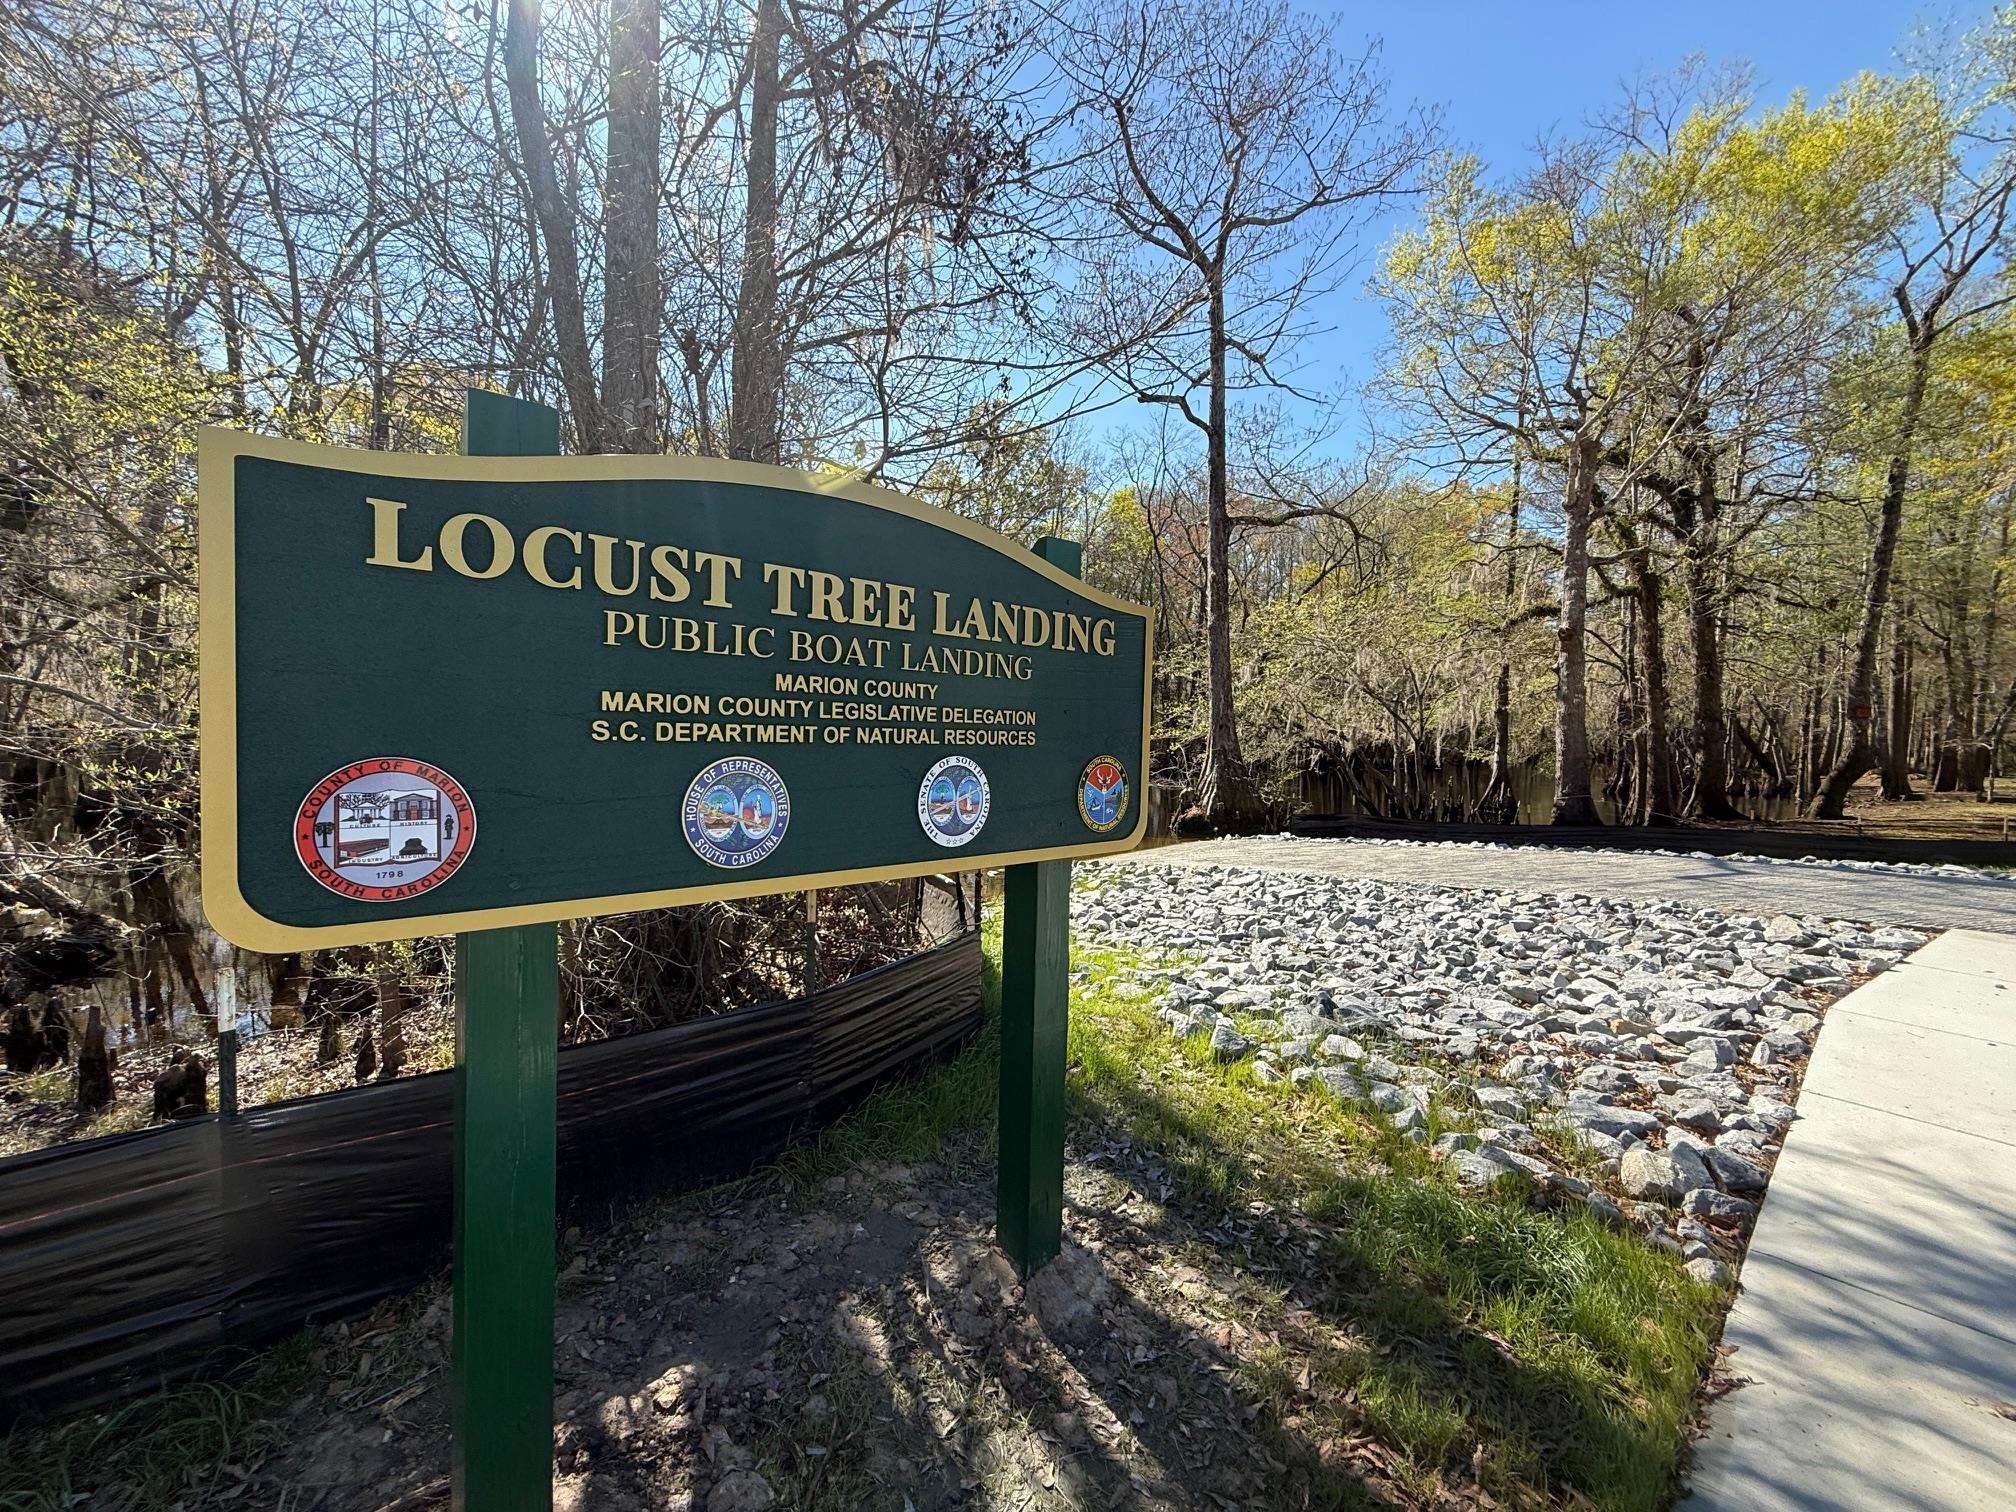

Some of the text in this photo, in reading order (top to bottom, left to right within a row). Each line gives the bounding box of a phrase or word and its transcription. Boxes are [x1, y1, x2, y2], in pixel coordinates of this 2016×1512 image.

[365, 496, 1116, 656] LOCUST TREE LANDING
[602, 609, 1033, 681] PUBLIC BOAT LANDING
[775, 673, 939, 700] MARION COUNTY
[601, 690, 1036, 726] MARION COUNTY LEGISLATIVE DELEGATION
[591, 720, 1036, 746] S.C. DEPARTMENT OF NATURAL RESOURCES
[938, 757, 952, 769] OF
[955, 756, 985, 778] SOUTH
[303, 761, 470, 819] COUNTY OF MARION
[686, 784, 705, 822] HOUSE
[703, 768, 717, 783] OF
[721, 760, 788, 818] REPRESENTATIVES
[920, 769, 937, 815] SENATE
[968, 781, 990, 837] CAROLINA
[923, 819, 941, 840] THE
[695, 834, 780, 866] SOUTH CAROLINA
[309, 849, 466, 899] SOUTH CAROLINA
[376, 870, 404, 879] 1798
